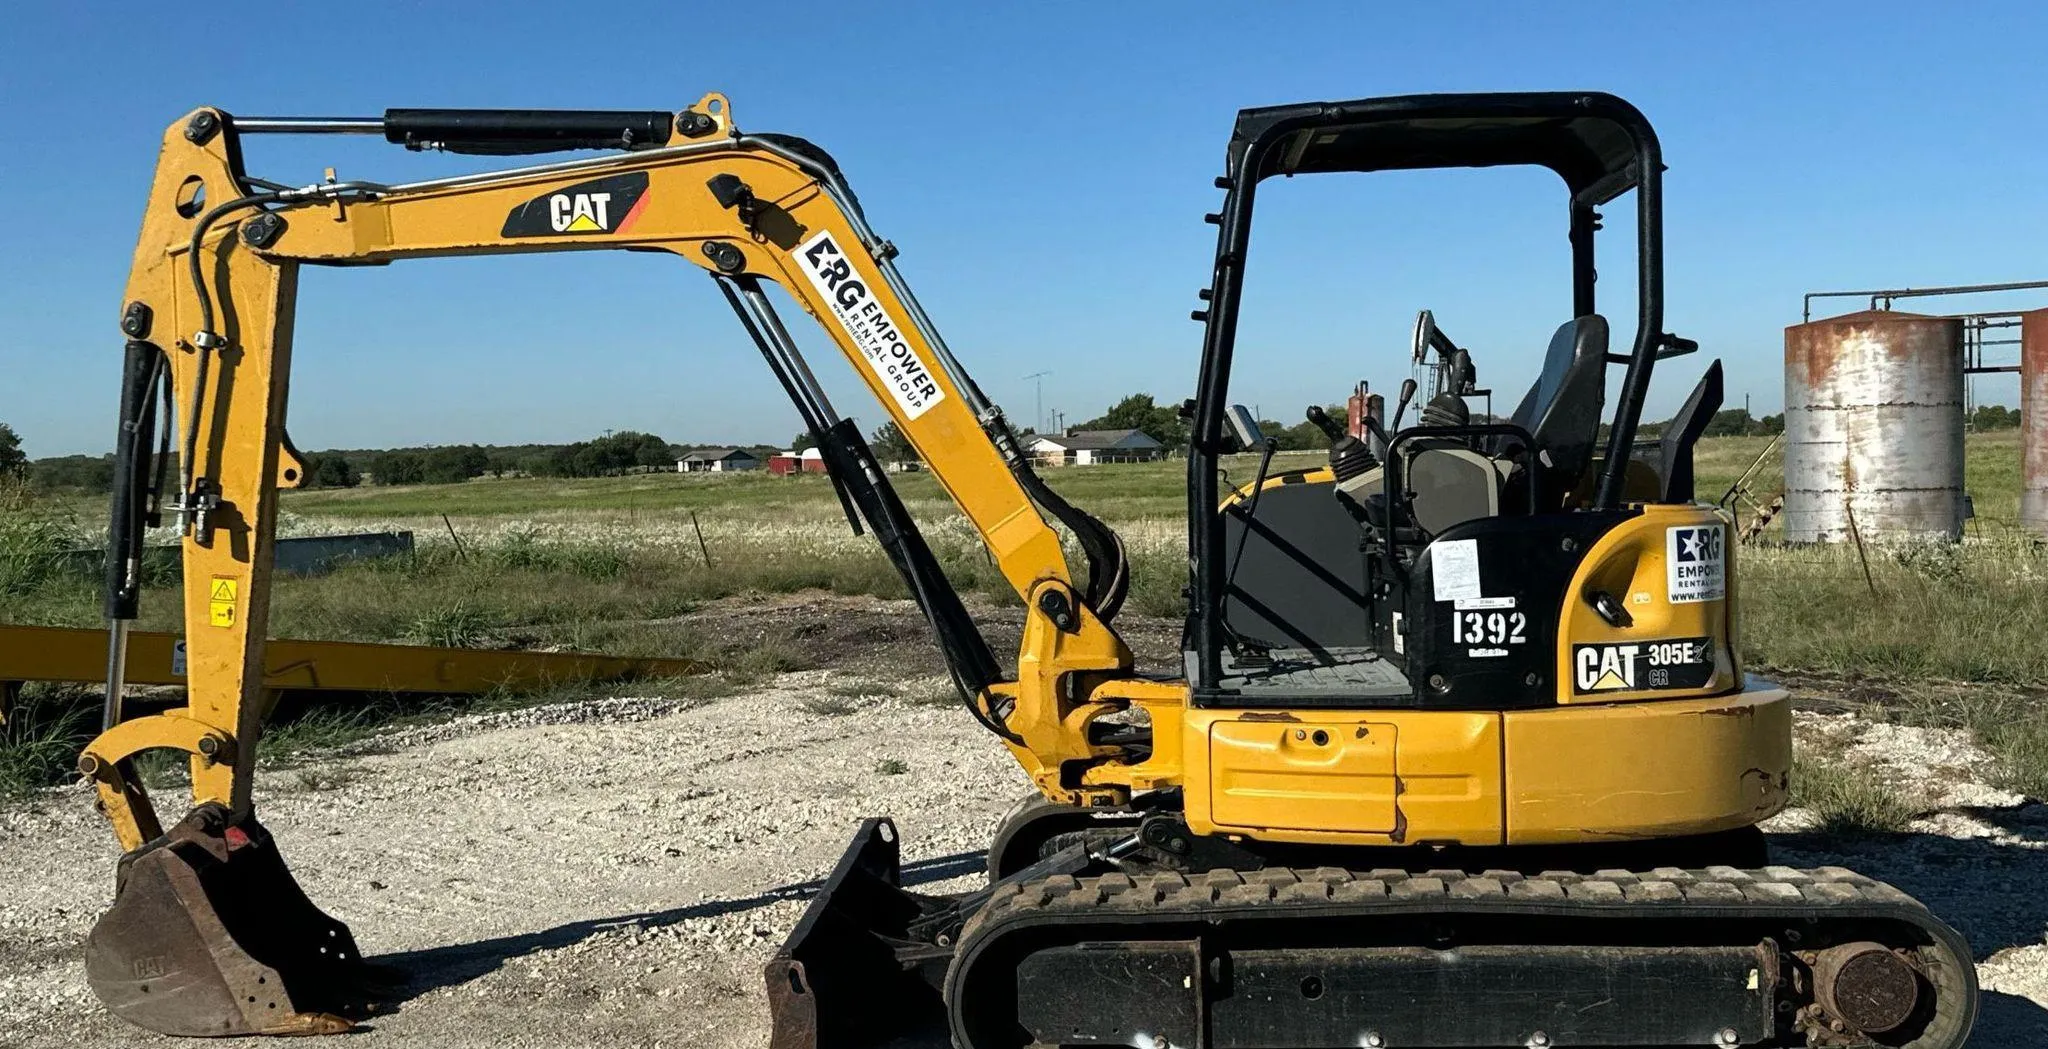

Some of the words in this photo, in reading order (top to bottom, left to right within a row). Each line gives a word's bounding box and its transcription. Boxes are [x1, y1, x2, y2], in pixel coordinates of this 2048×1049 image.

[550, 193, 610, 232] CAT
[832, 303, 875, 360] www.rentERG.com
[861, 301, 936, 401] EMPOWER
[850, 314, 888, 363] RENTAL
[887, 365, 921, 409] GROUP
[1453, 611, 1526, 645] 1392
[1577, 645, 1639, 691] CAT
[1648, 642, 1703, 666] 305E2
[1648, 668, 1669, 687] CR
